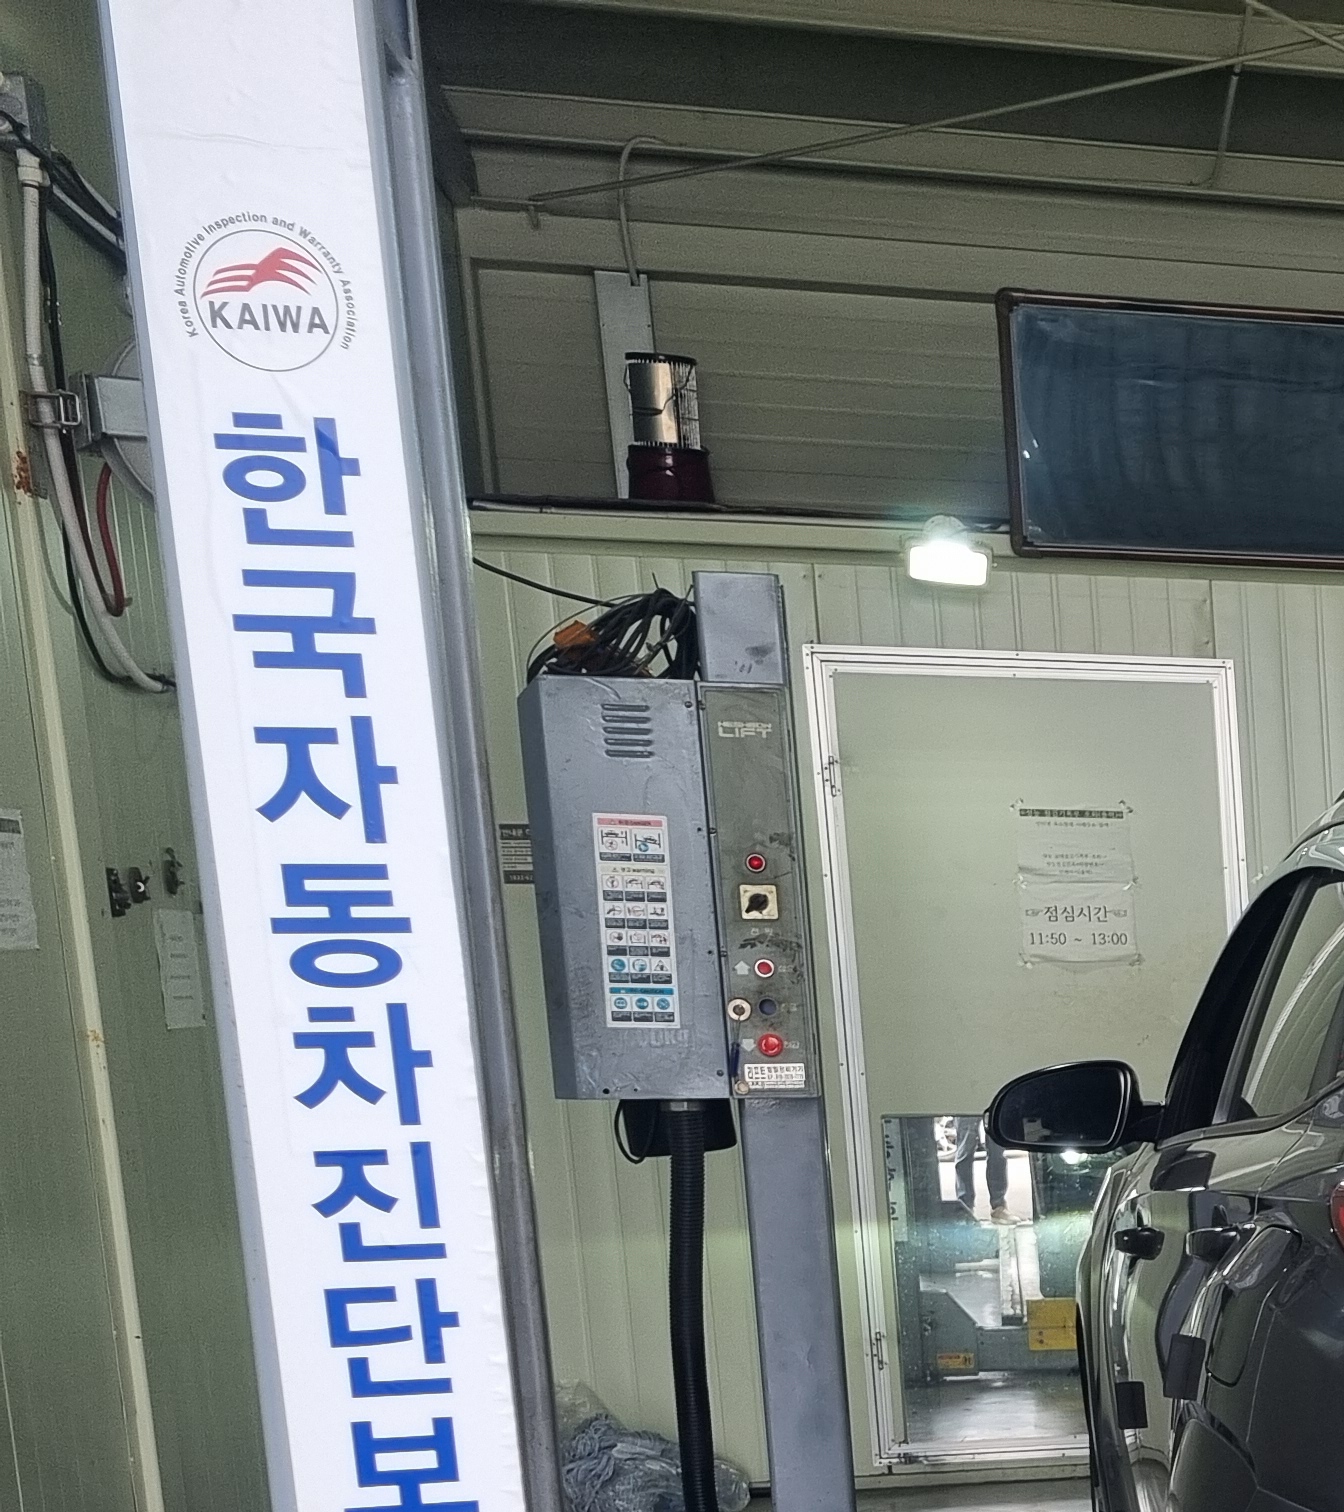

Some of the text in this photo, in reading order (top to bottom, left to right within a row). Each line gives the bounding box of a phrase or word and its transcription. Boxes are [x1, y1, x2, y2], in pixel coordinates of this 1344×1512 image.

[174, 212, 358, 350] Korea Automotive Inspection and Warranty Association
[208, 300, 330, 335] KAIWA
[718, 727, 772, 738] LIFT
[1044, 905, 1108, 922] 점심시간
[1030, 932, 1067, 945] 11:50
[1091, 932, 1128, 945] 13:00
